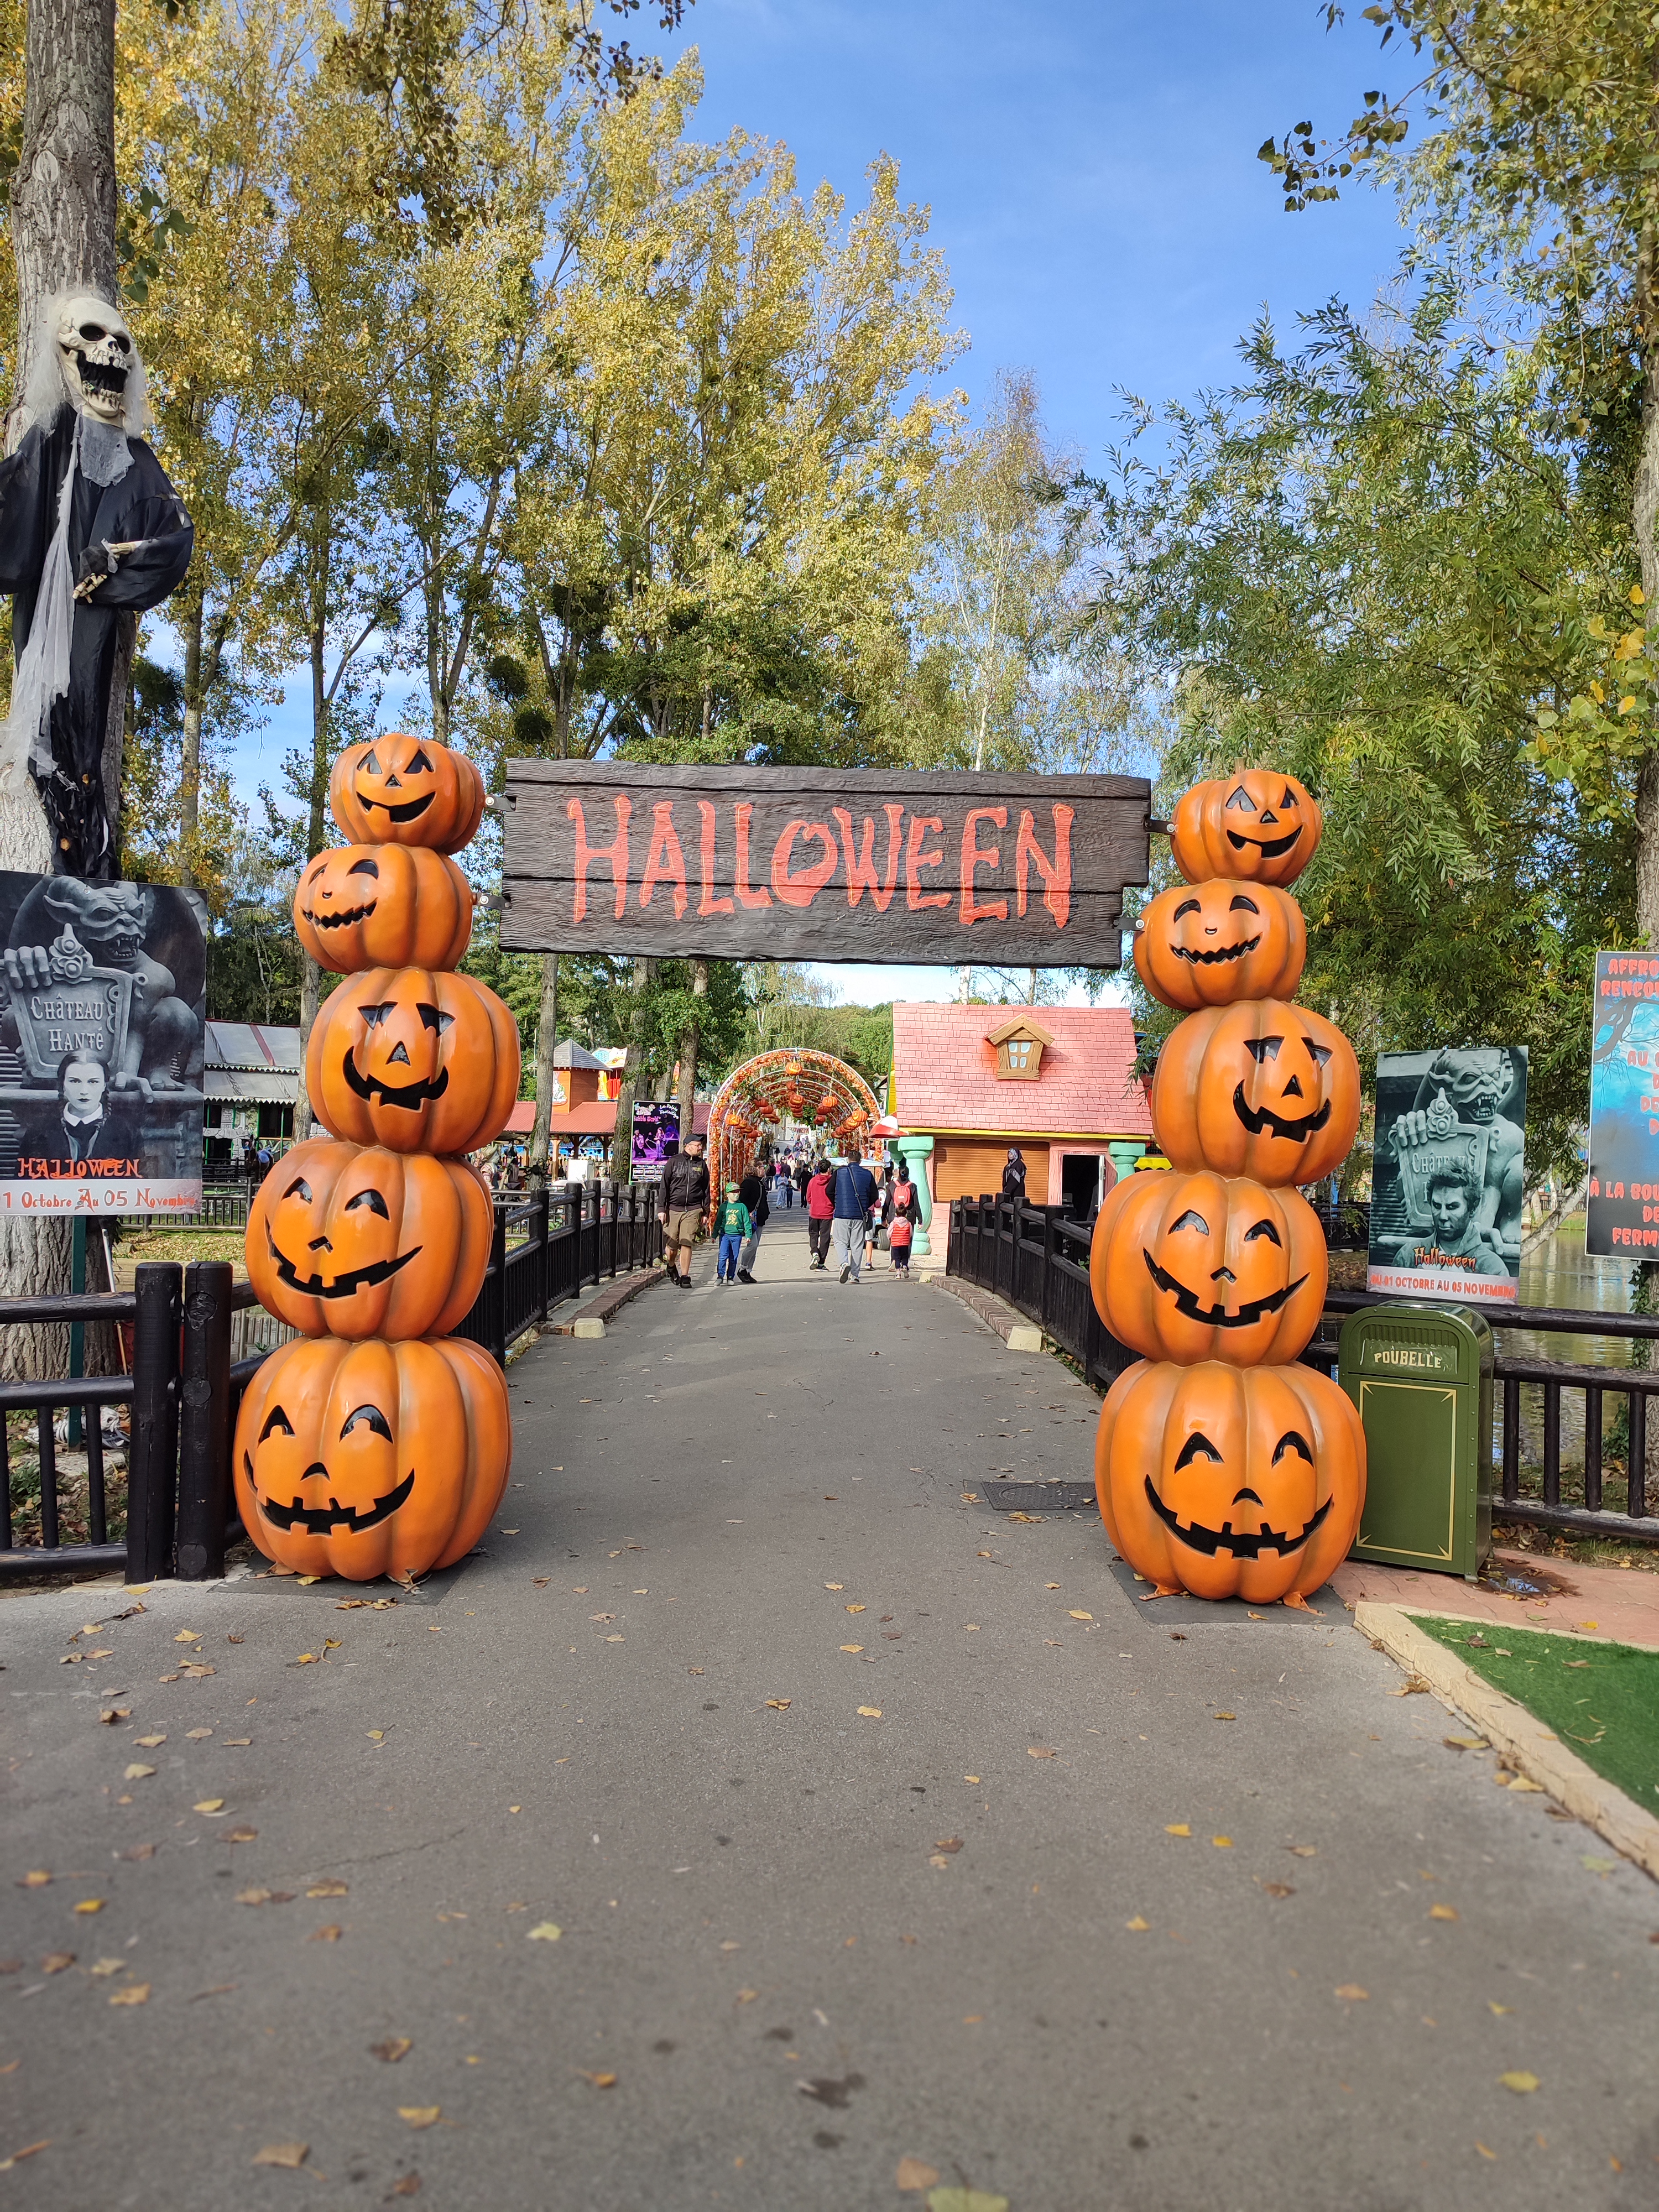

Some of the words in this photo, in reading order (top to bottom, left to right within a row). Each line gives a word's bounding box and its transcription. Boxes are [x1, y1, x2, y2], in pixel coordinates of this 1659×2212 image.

[567, 794, 1075, 928] HALLOWEEN
[1608, 958, 1659, 977] AFFRO
[1627, 1050, 1648, 1067] AU
[18, 1157, 143, 1180] HALLOWEEN
[1590, 1176, 1600, 1197] À
[1605, 1181, 1625, 1199] LA
[22, 1191, 72, 1208] Octobre
[75, 1188, 99, 1213] Au
[104, 1190, 128, 1207] 05
[1612, 1227, 1659, 1248] FERM
[1413, 1246, 1477, 1271] Halloween
[1385, 1275, 1393, 1287] 01
[1395, 1276, 1434, 1291] OCTOBRE
[1437, 1279, 1450, 1292] AU
[1452, 1281, 1462, 1293] 05
[1374, 1350, 1442, 1369] POUBELLE
